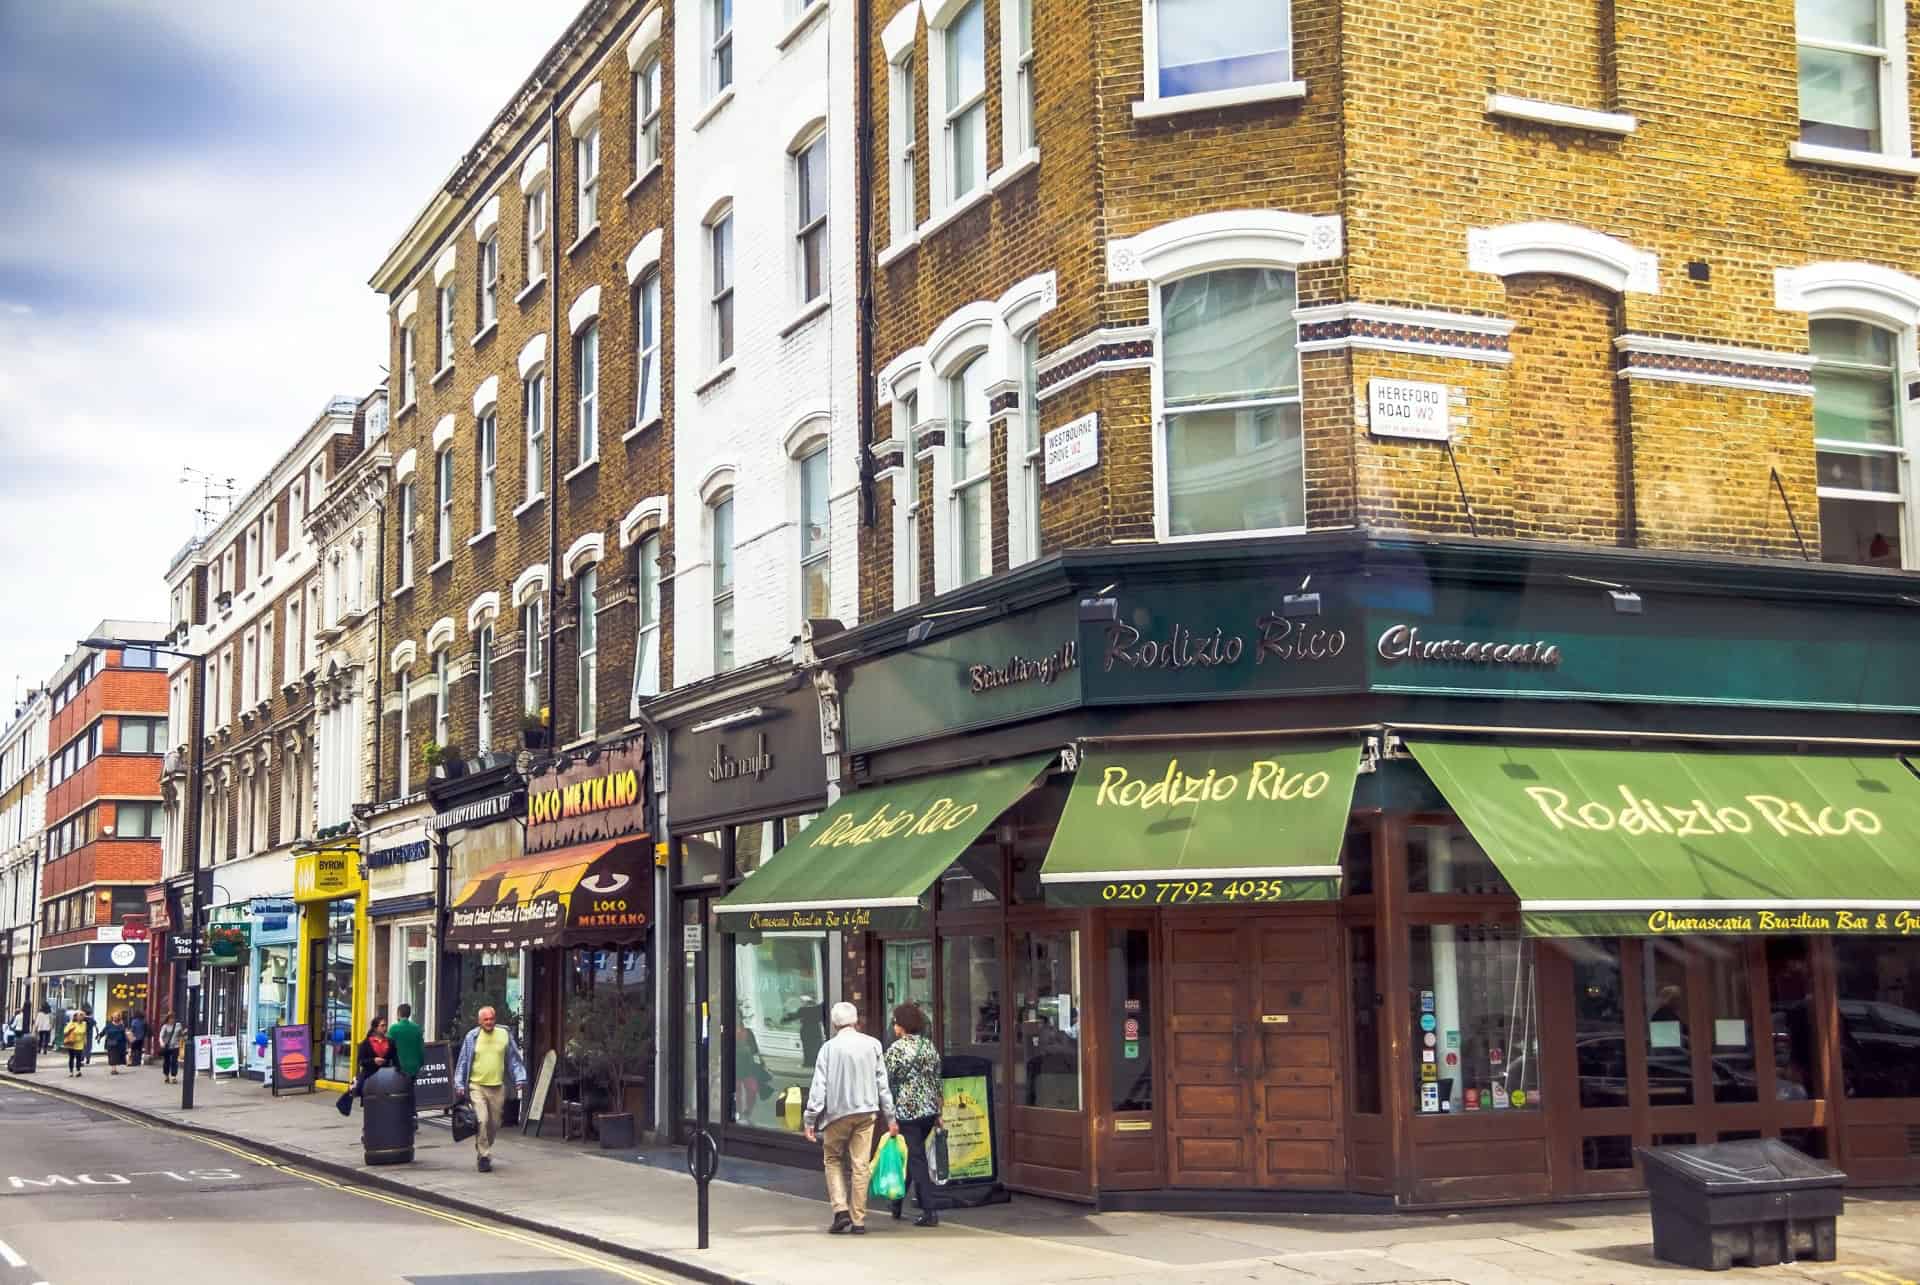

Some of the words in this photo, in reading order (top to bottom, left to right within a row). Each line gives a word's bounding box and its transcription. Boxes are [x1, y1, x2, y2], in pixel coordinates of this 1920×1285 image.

[1377, 385, 1439, 404] HEREFORD
[1378, 402, 1410, 418] ROAD
[1415, 406, 1434, 421] W2
[1048, 420, 1092, 449] WESTBOURNE
[1048, 446, 1070, 465] GROVE
[1104, 619, 1243, 673] Rodizio
[1255, 610, 1346, 665] Rico
[1377, 623, 1561, 666] Churrascaria
[1096, 758, 1240, 809] Rodizio
[1246, 760, 1331, 801] Rico
[528, 788, 561, 826] LOCO
[562, 769, 638, 817] MEXICANO
[1524, 784, 1753, 838] Rodizio
[1745, 794, 1883, 838] Rico
[809, 802, 914, 849] Rodizio
[903, 797, 979, 838] Rico
[319, 860, 345, 871] BYRON
[1102, 883, 1147, 900] 020
[1155, 880, 1214, 903] 7792
[1222, 879, 1283, 901] 4035
[594, 900, 627, 912] LOCO
[578, 913, 646, 927] MEXICANO
[1649, 910, 1751, 932] Churrascaria
[1758, 911, 1829, 929] Brazilian
[1836, 911, 1868, 929] Bar
[1876, 913, 1888, 928] &
[8, 1168, 241, 1188] SLOW
